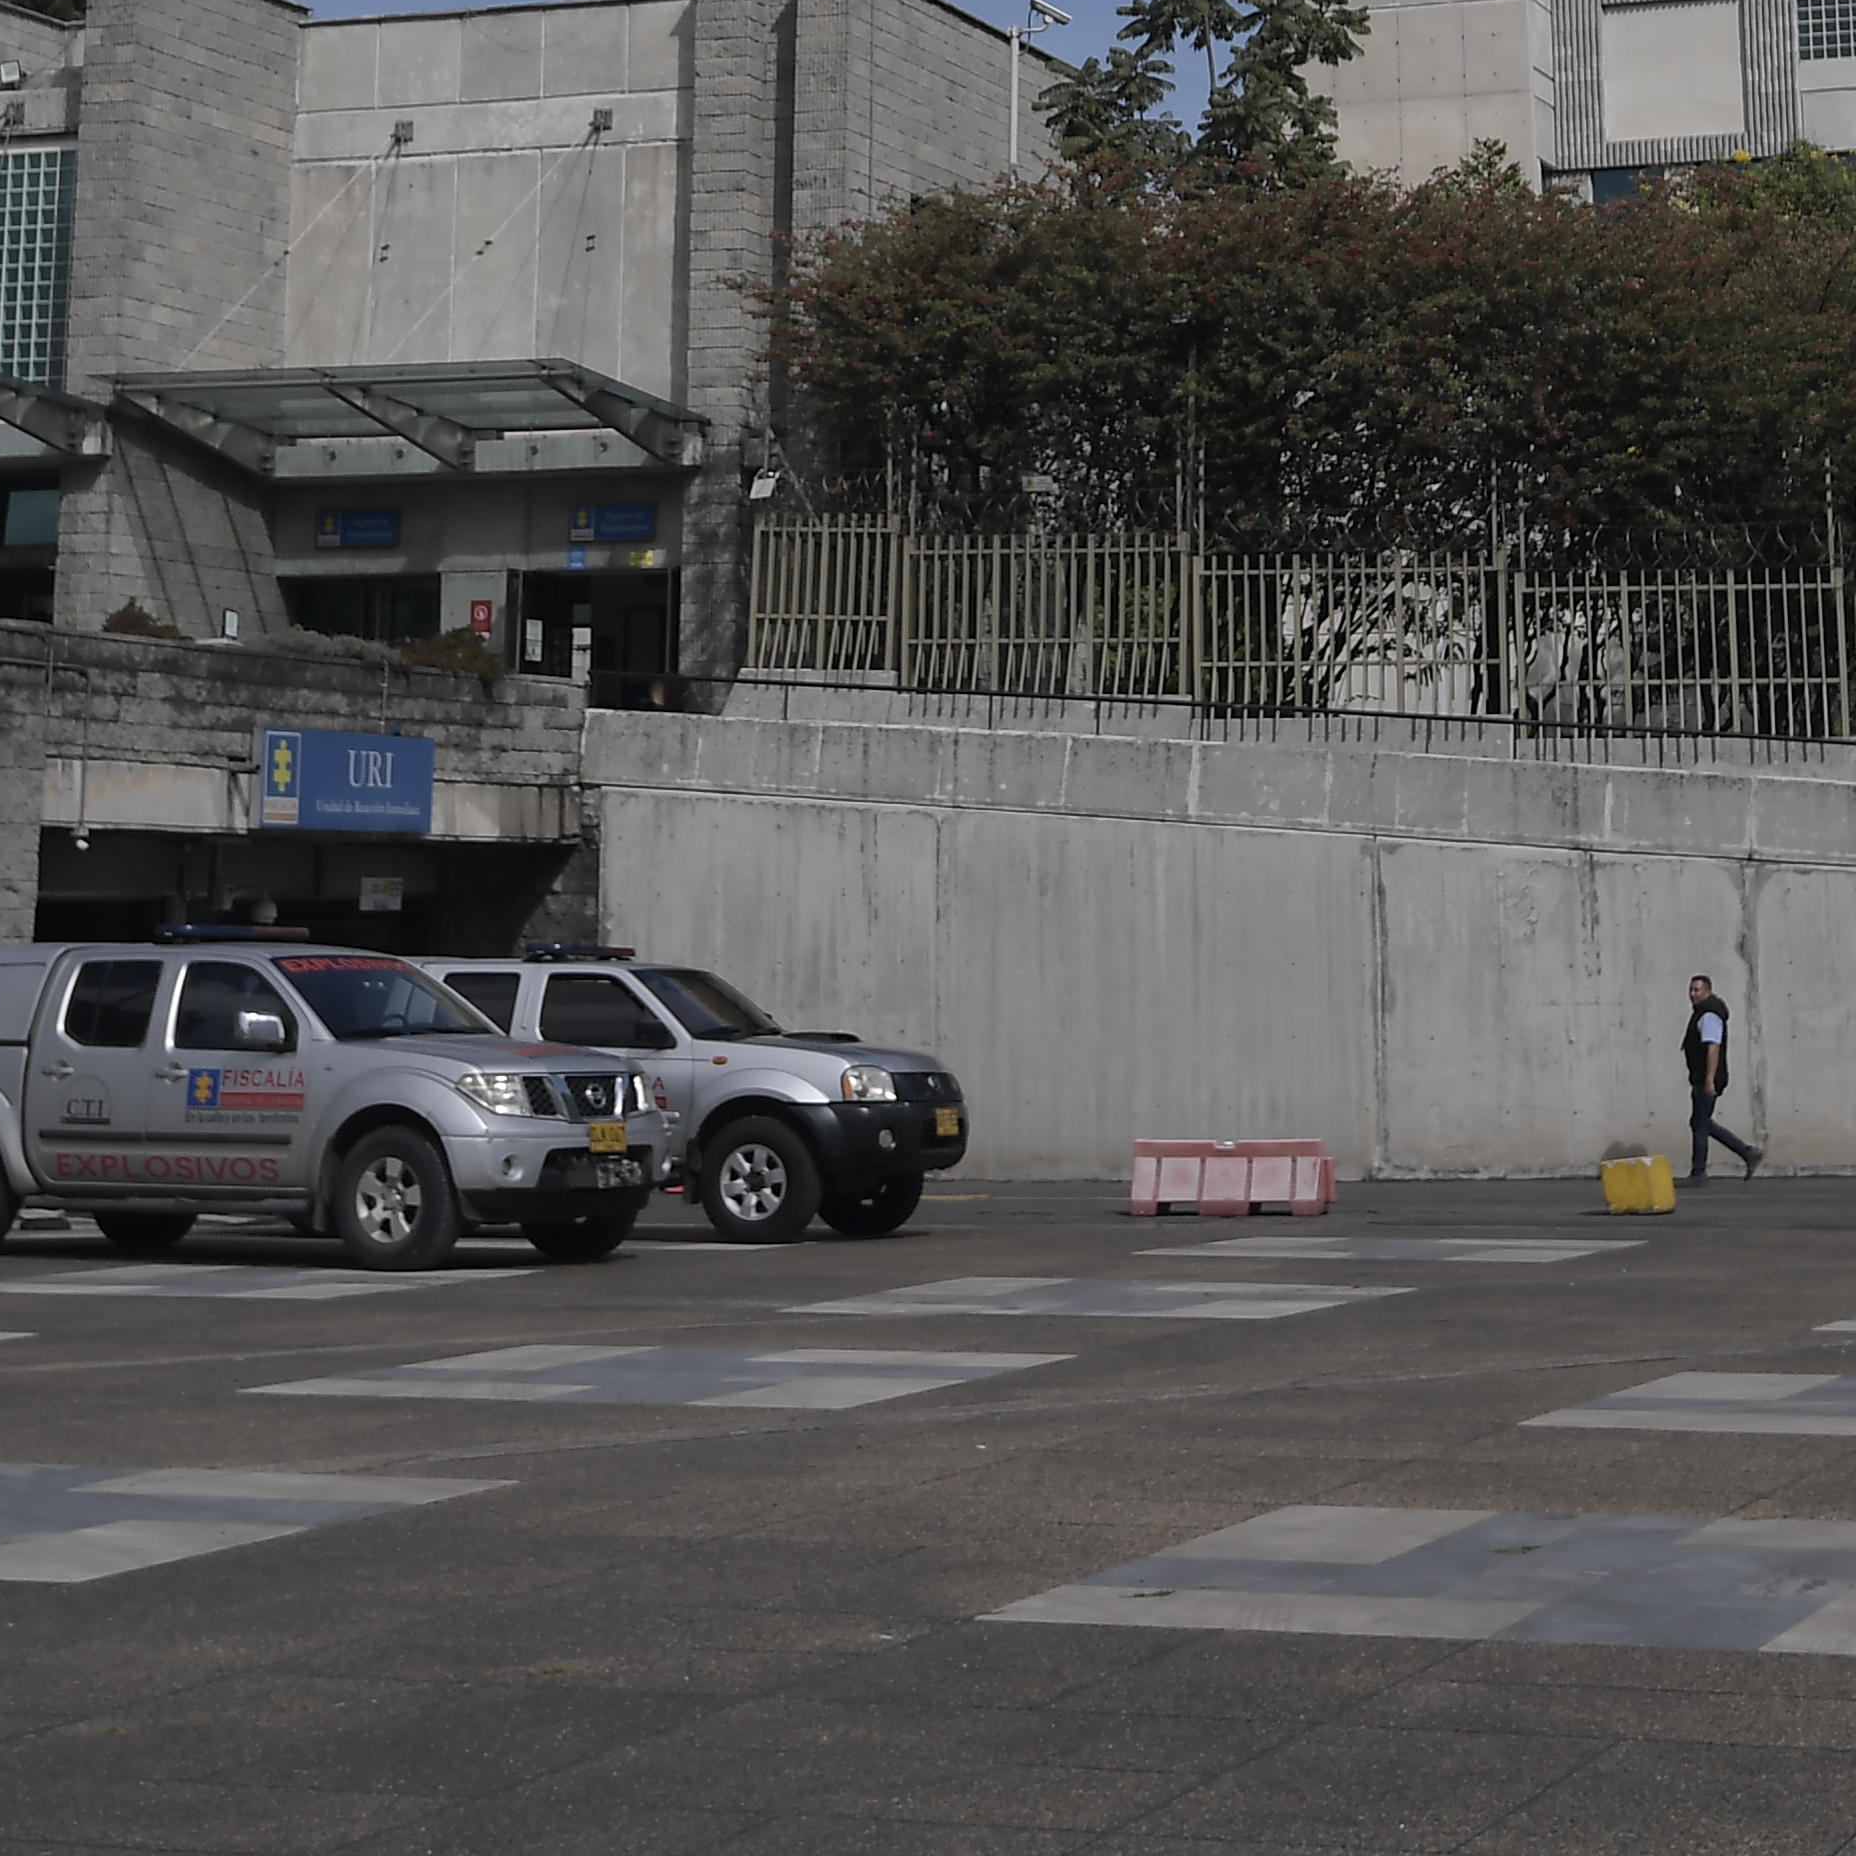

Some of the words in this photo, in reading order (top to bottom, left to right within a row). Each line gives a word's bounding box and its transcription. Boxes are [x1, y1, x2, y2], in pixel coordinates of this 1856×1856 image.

[348, 749, 394, 788] URI
[222, 1067, 306, 1088] FISCALÍA
[56, 1154, 281, 1182] EXPLOSIVOS
